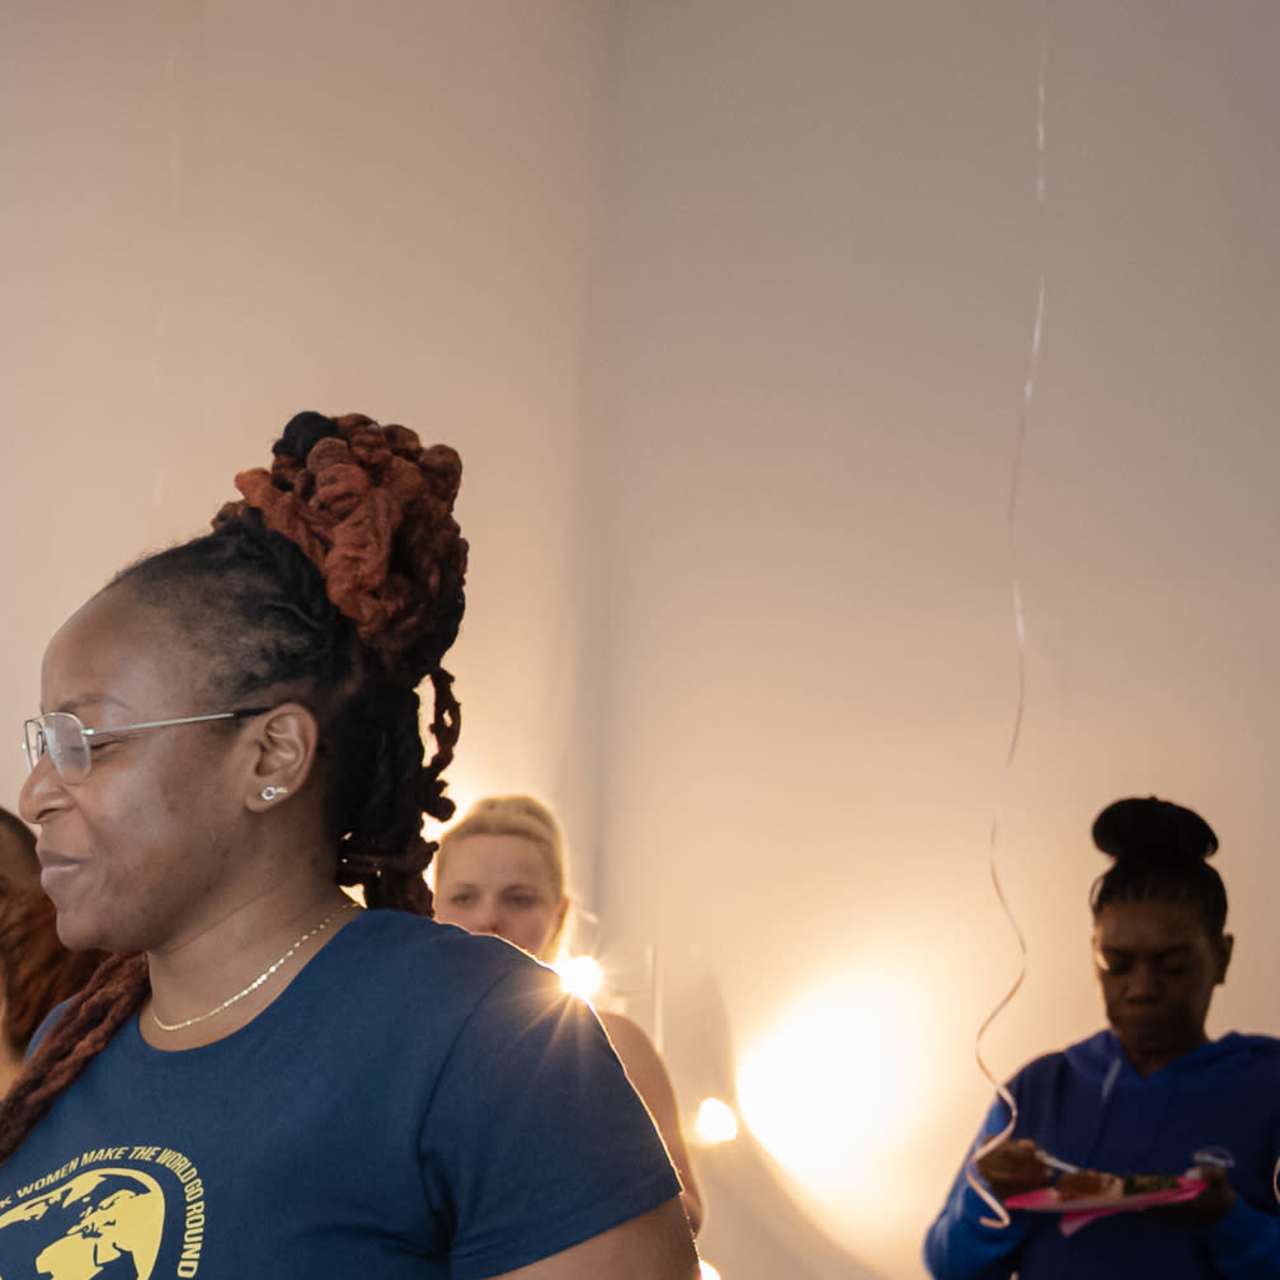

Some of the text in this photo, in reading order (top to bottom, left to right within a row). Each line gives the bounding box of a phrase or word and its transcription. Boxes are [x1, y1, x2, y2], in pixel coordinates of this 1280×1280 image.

[80, 1146, 129, 1167] MAKE
[128, 1146, 161, 1161] THE
[155, 1147, 198, 1184] WORLD
[16, 1157, 80, 1199] WOMEN
[184, 1178, 205, 1203] GO
[177, 1201, 206, 1279] ROUND
